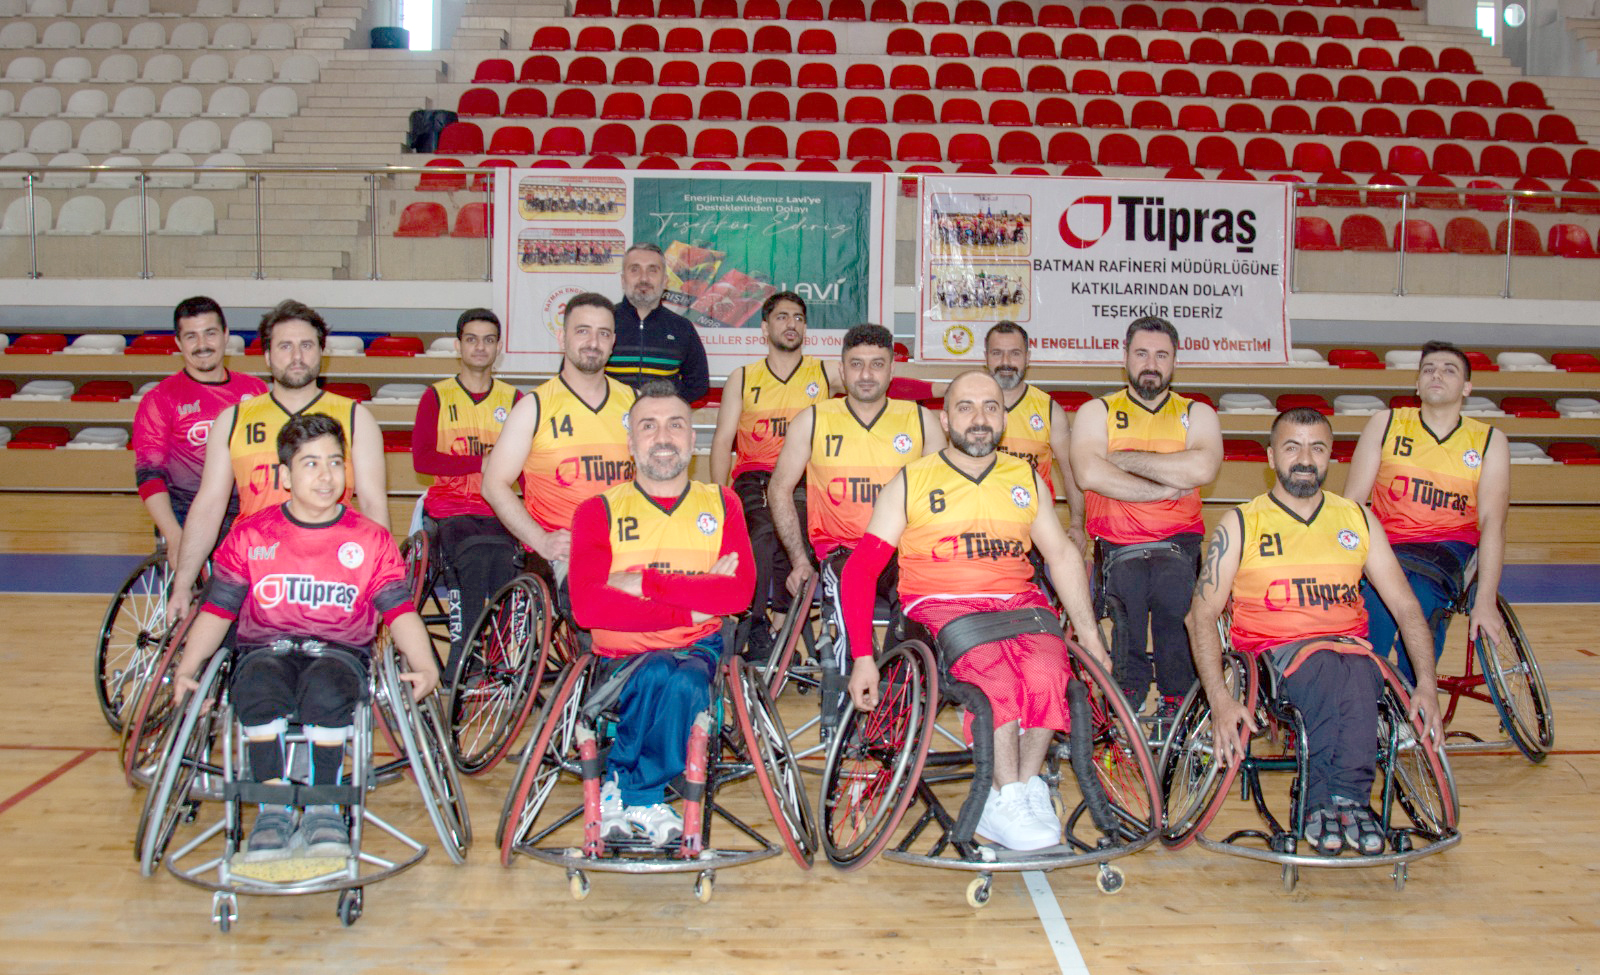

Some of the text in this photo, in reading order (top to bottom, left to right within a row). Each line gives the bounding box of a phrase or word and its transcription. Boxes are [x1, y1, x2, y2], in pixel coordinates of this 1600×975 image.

[684, 194, 821, 205] Enerjimizi Aldığımız Lavi'ye
[696, 204, 809, 214] Desteklerinden Dolayı
[1117, 196, 1257, 253] Tüpraş
[1033, 257, 1279, 276] BATMAN RAFİNERİ MÜDÜRLÜĞÜNE
[1071, 282, 1243, 297] KATKILARINDAN DOLAYI
[1092, 302, 1223, 319] TEŞEKKÜR EDERİZ
[700, 334, 742, 345] ELLİLER
[1041, 335, 1119, 350] ENGELLİLER
[1177, 337, 1210, 351] LÜBÜ
[1213, 337, 1271, 352] YÖNETİMİ
[751, 386, 761, 404] 7
[448, 404, 458, 422] 11
[1116, 410, 1128, 429] 9
[246, 422, 266, 445] 16
[550, 414, 573, 438] 14
[825, 435, 843, 457] 17
[1393, 436, 1414, 457] 15
[929, 488, 946, 514] 6
[1411, 477, 1469, 516] Tüpraş
[617, 516, 640, 542] 12
[1259, 533, 1283, 557] 21
[286, 576, 357, 609] Tüpraş
[450, 589, 462, 642] EXTRA
